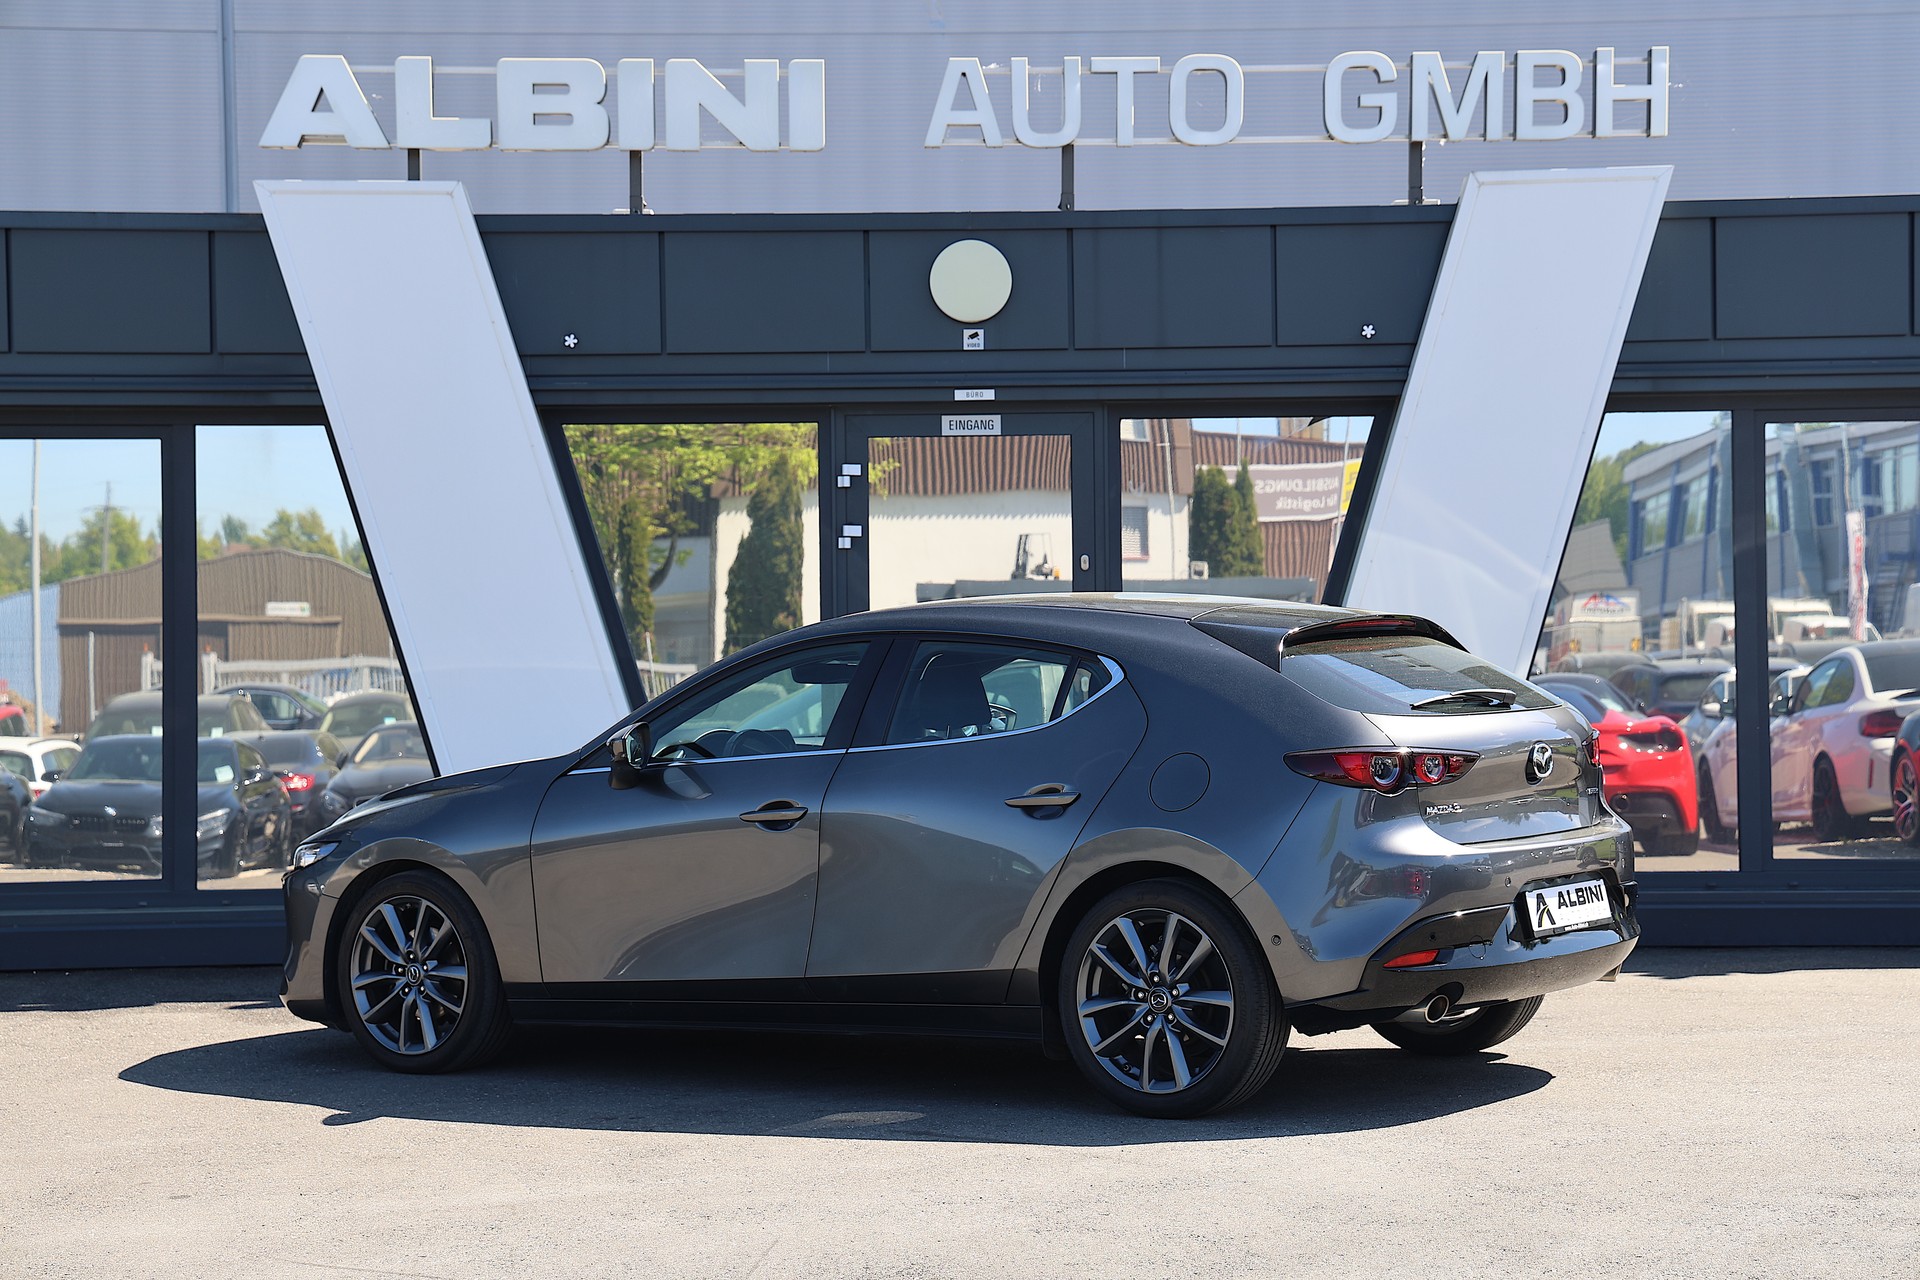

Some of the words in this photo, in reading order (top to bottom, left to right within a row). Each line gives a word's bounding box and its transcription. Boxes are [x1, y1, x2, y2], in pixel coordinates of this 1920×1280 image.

[258, 54, 826, 152] ALBINI
[923, 53, 1244, 149] AUTO
[1323, 45, 1669, 143] GMBH
[949, 419, 994, 430] EINGANG
[1557, 884, 1604, 910] ALBINI
